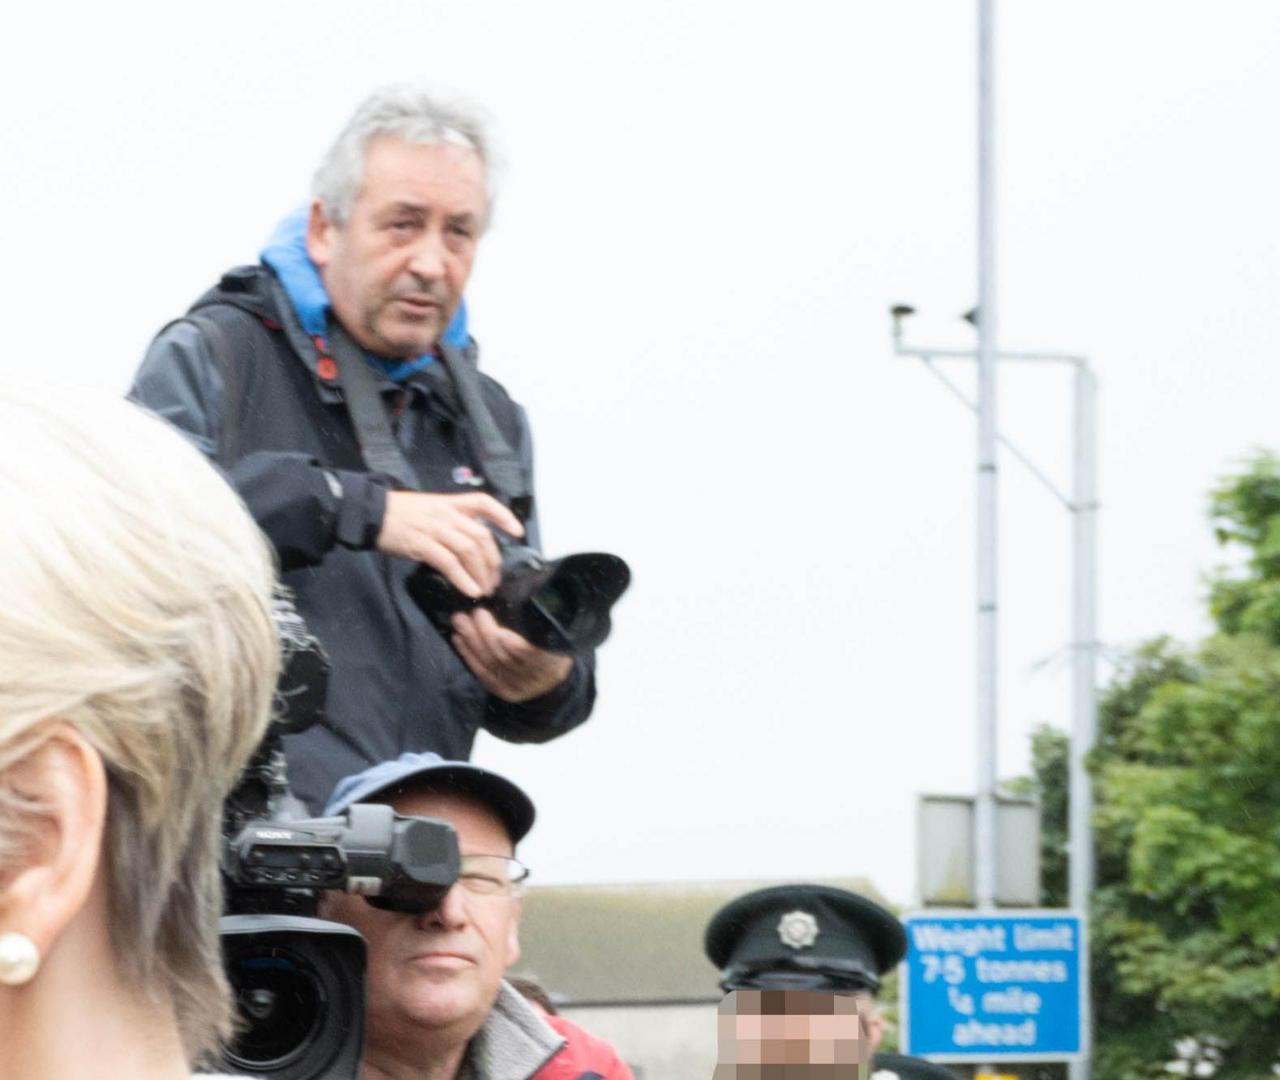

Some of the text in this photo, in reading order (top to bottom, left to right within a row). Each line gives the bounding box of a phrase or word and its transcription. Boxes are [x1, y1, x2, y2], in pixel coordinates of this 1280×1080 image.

[911, 924, 1074, 957] Weight limit
[975, 956, 1069, 983] tonnes
[981, 985, 1043, 1015] mile
[952, 1018, 1037, 1046] ahead
